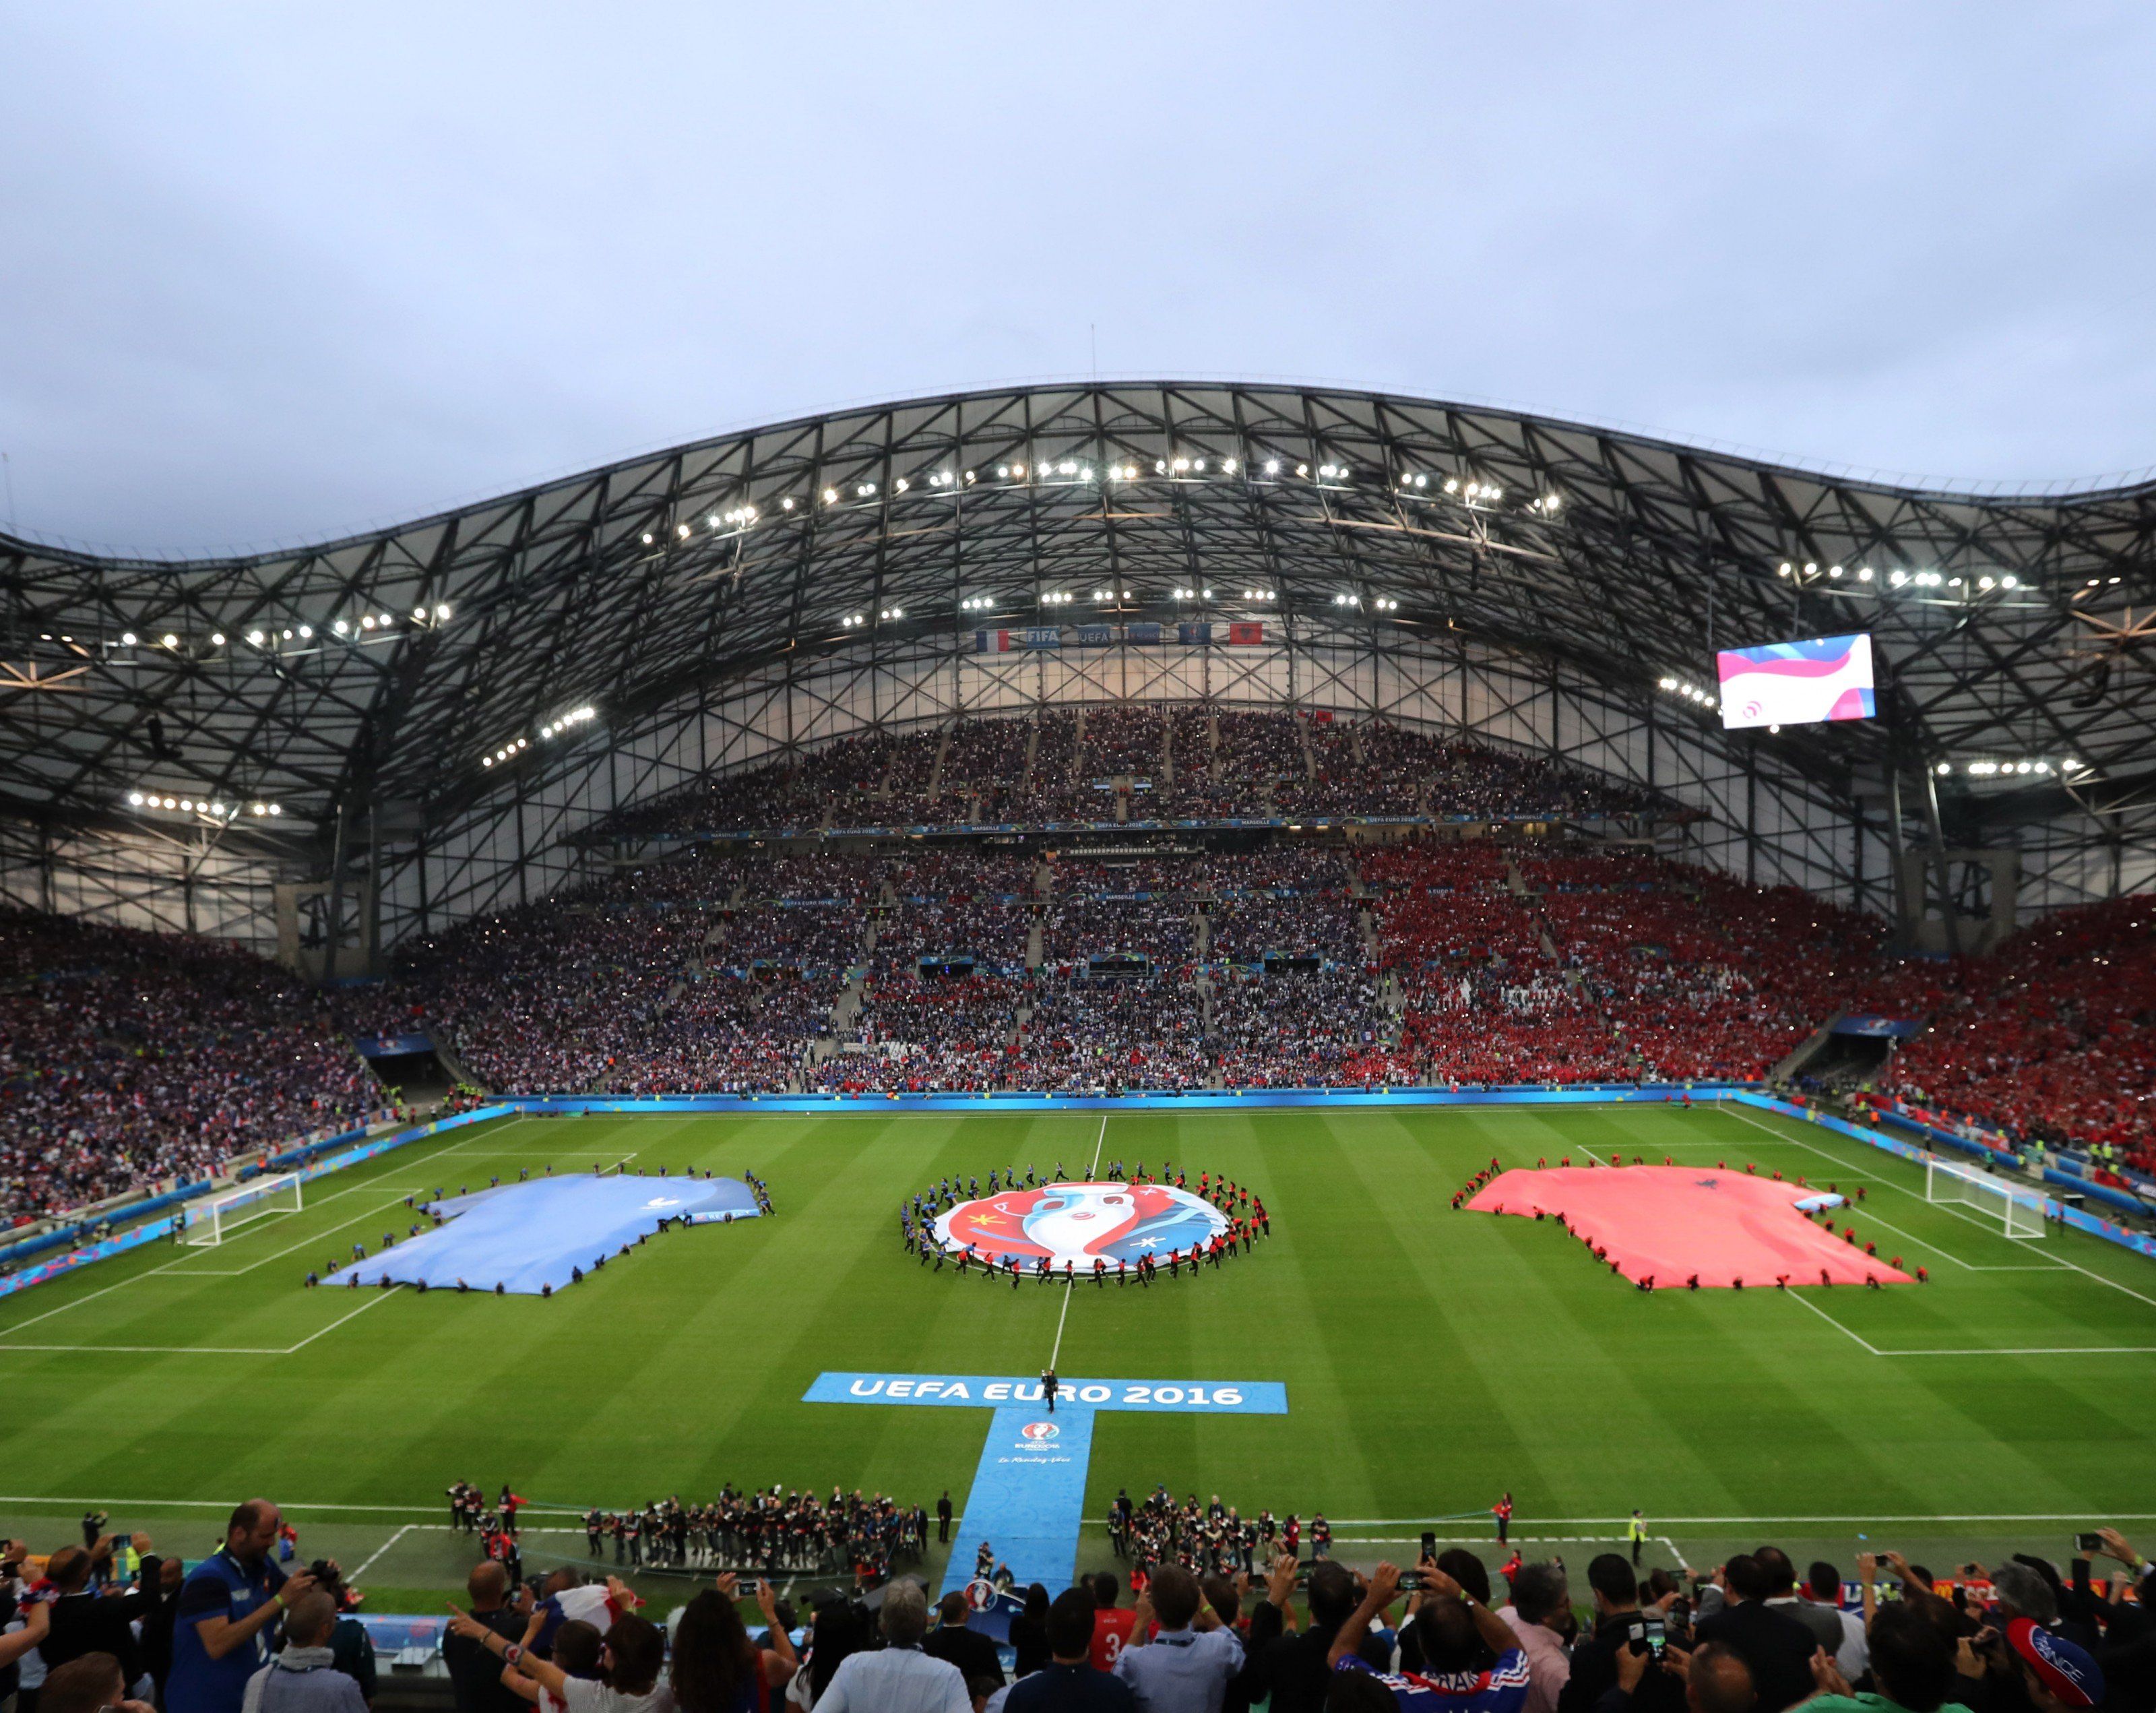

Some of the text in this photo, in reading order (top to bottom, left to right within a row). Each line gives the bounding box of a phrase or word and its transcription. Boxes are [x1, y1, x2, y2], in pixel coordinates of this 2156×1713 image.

[1027, 630, 1058, 642] FIFA
[1079, 632, 1109, 642] UEFA
[850, 1379, 970, 1399] UEFA
[1122, 1386, 1244, 1406] 2016
[1106, 1633, 1120, 1662] 3
